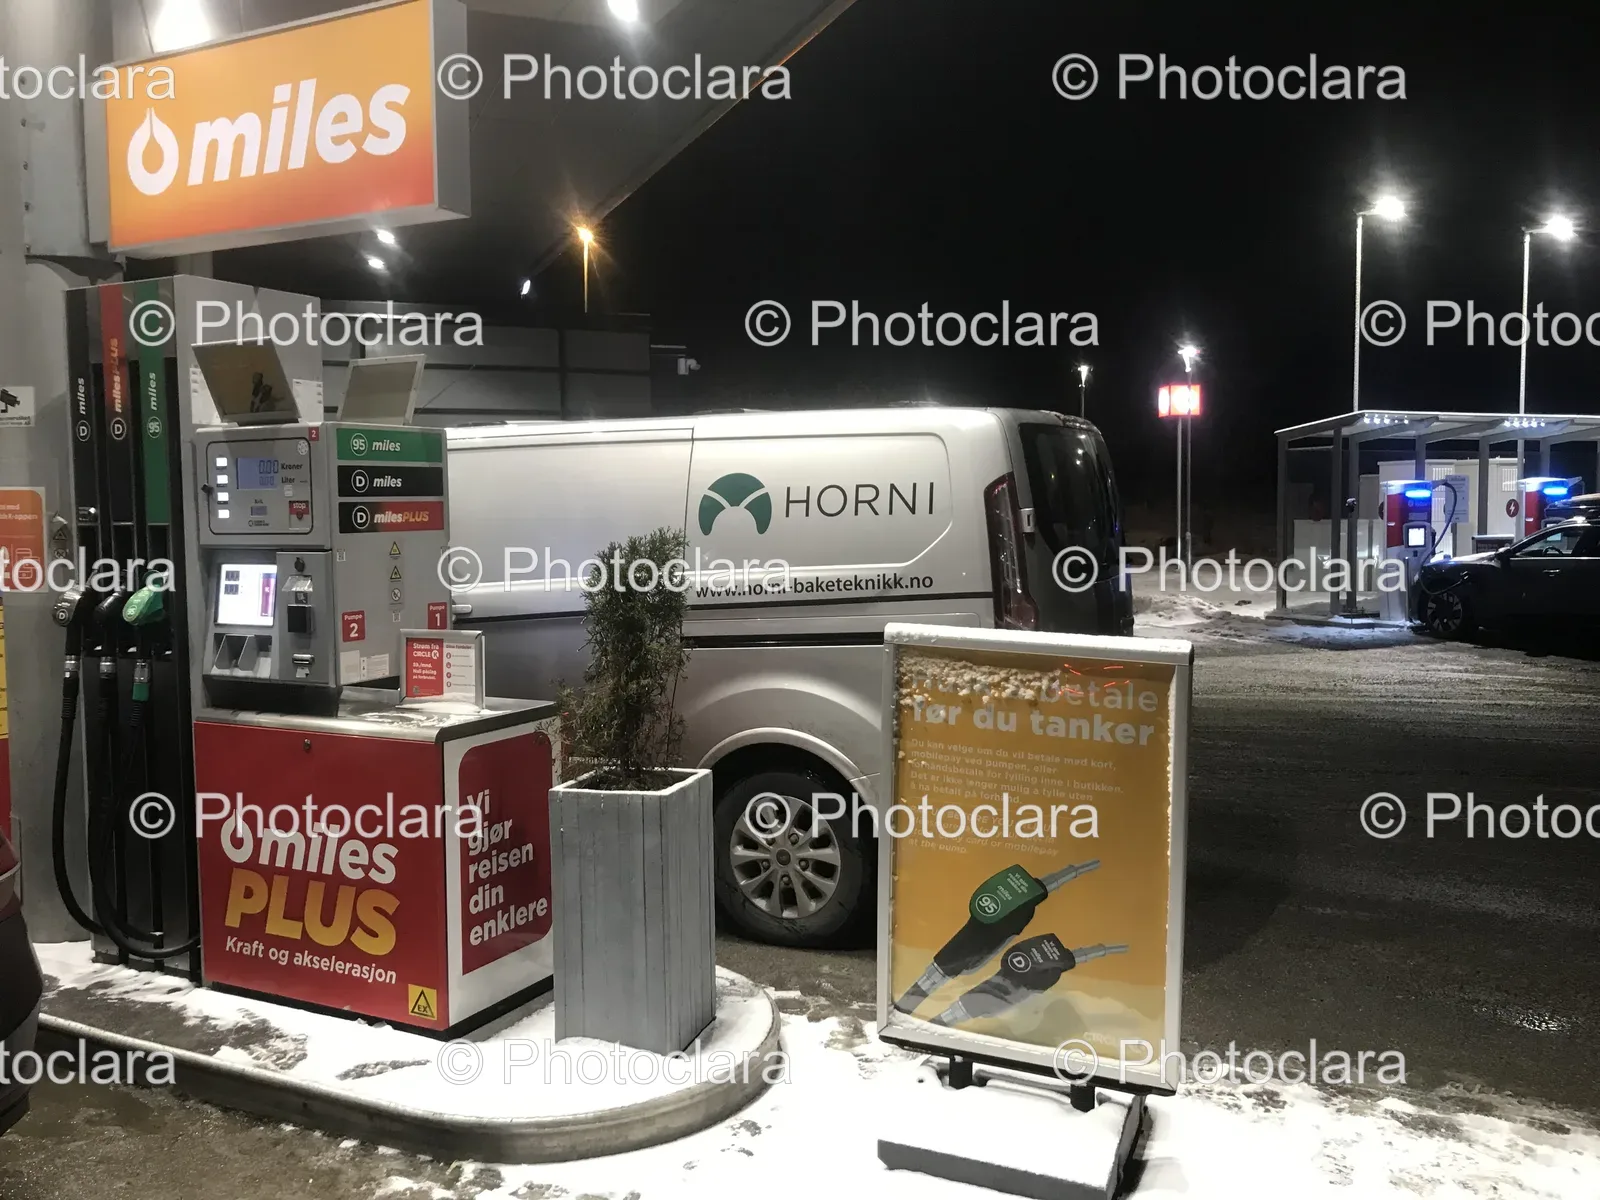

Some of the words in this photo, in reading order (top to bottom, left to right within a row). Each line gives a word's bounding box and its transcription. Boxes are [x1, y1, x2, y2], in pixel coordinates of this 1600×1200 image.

[187, 78, 411, 187] miles
[78, 378, 86, 414] miles
[80, 426, 87, 436] D
[115, 423, 122, 434] D
[148, 421, 160, 433] 95
[352, 438, 366, 451] 95
[372, 440, 401, 452] miles
[281, 463, 303, 471] Kroner
[281, 476, 295, 484] Liter
[356, 474, 366, 487] D
[373, 476, 402, 488] miles
[785, 481, 935, 518] HORNI
[356, 511, 366, 523] D
[695, 572, 934, 599] www.horni-baketeknikk.no
[349, 623, 359, 638] 2
[435, 613, 441, 626] 1
[1038, 677, 1158, 712] betale
[911, 699, 962, 725] før
[974, 703, 1017, 733] du
[1030, 708, 1155, 746] tanker
[911, 738, 924, 748] Du
[926, 740, 944, 750] kan
[947, 743, 974, 754] velge
[977, 747, 993, 756] om
[996, 747, 1009, 758] du
[1012, 748, 1025, 759] vil
[1028, 751, 1060, 764] betale
[1064, 755, 1088, 767] med
[911, 749, 962, 765] mobilepay
[964, 755, 982, 766] ved
[1033, 763, 1057, 774] eller
[910, 769, 928, 781] Det
[943, 773, 963, 785] ikke
[1000, 780, 1030, 795] mulig
[1068, 791, 1093, 802] uten
[987, 767, 1002, 778] for
[1004, 769, 1038, 784] fylling
[1041, 775, 1063, 787] inne
[467, 788, 491, 817] Vi
[467, 816, 513, 857] gjør
[921, 839, 937, 849] the
[258, 822, 400, 885] miles
[468, 840, 535, 884] reisen
[469, 880, 505, 915] din
[979, 896, 998, 914] 95
[224, 866, 401, 956] PLUS
[469, 895, 549, 946] enklere
[226, 935, 265, 958] Kraft
[268, 947, 289, 966] og
[293, 950, 397, 985] akselerasjon
[1012, 956, 1025, 968] D
[417, 1004, 429, 1014] EX
